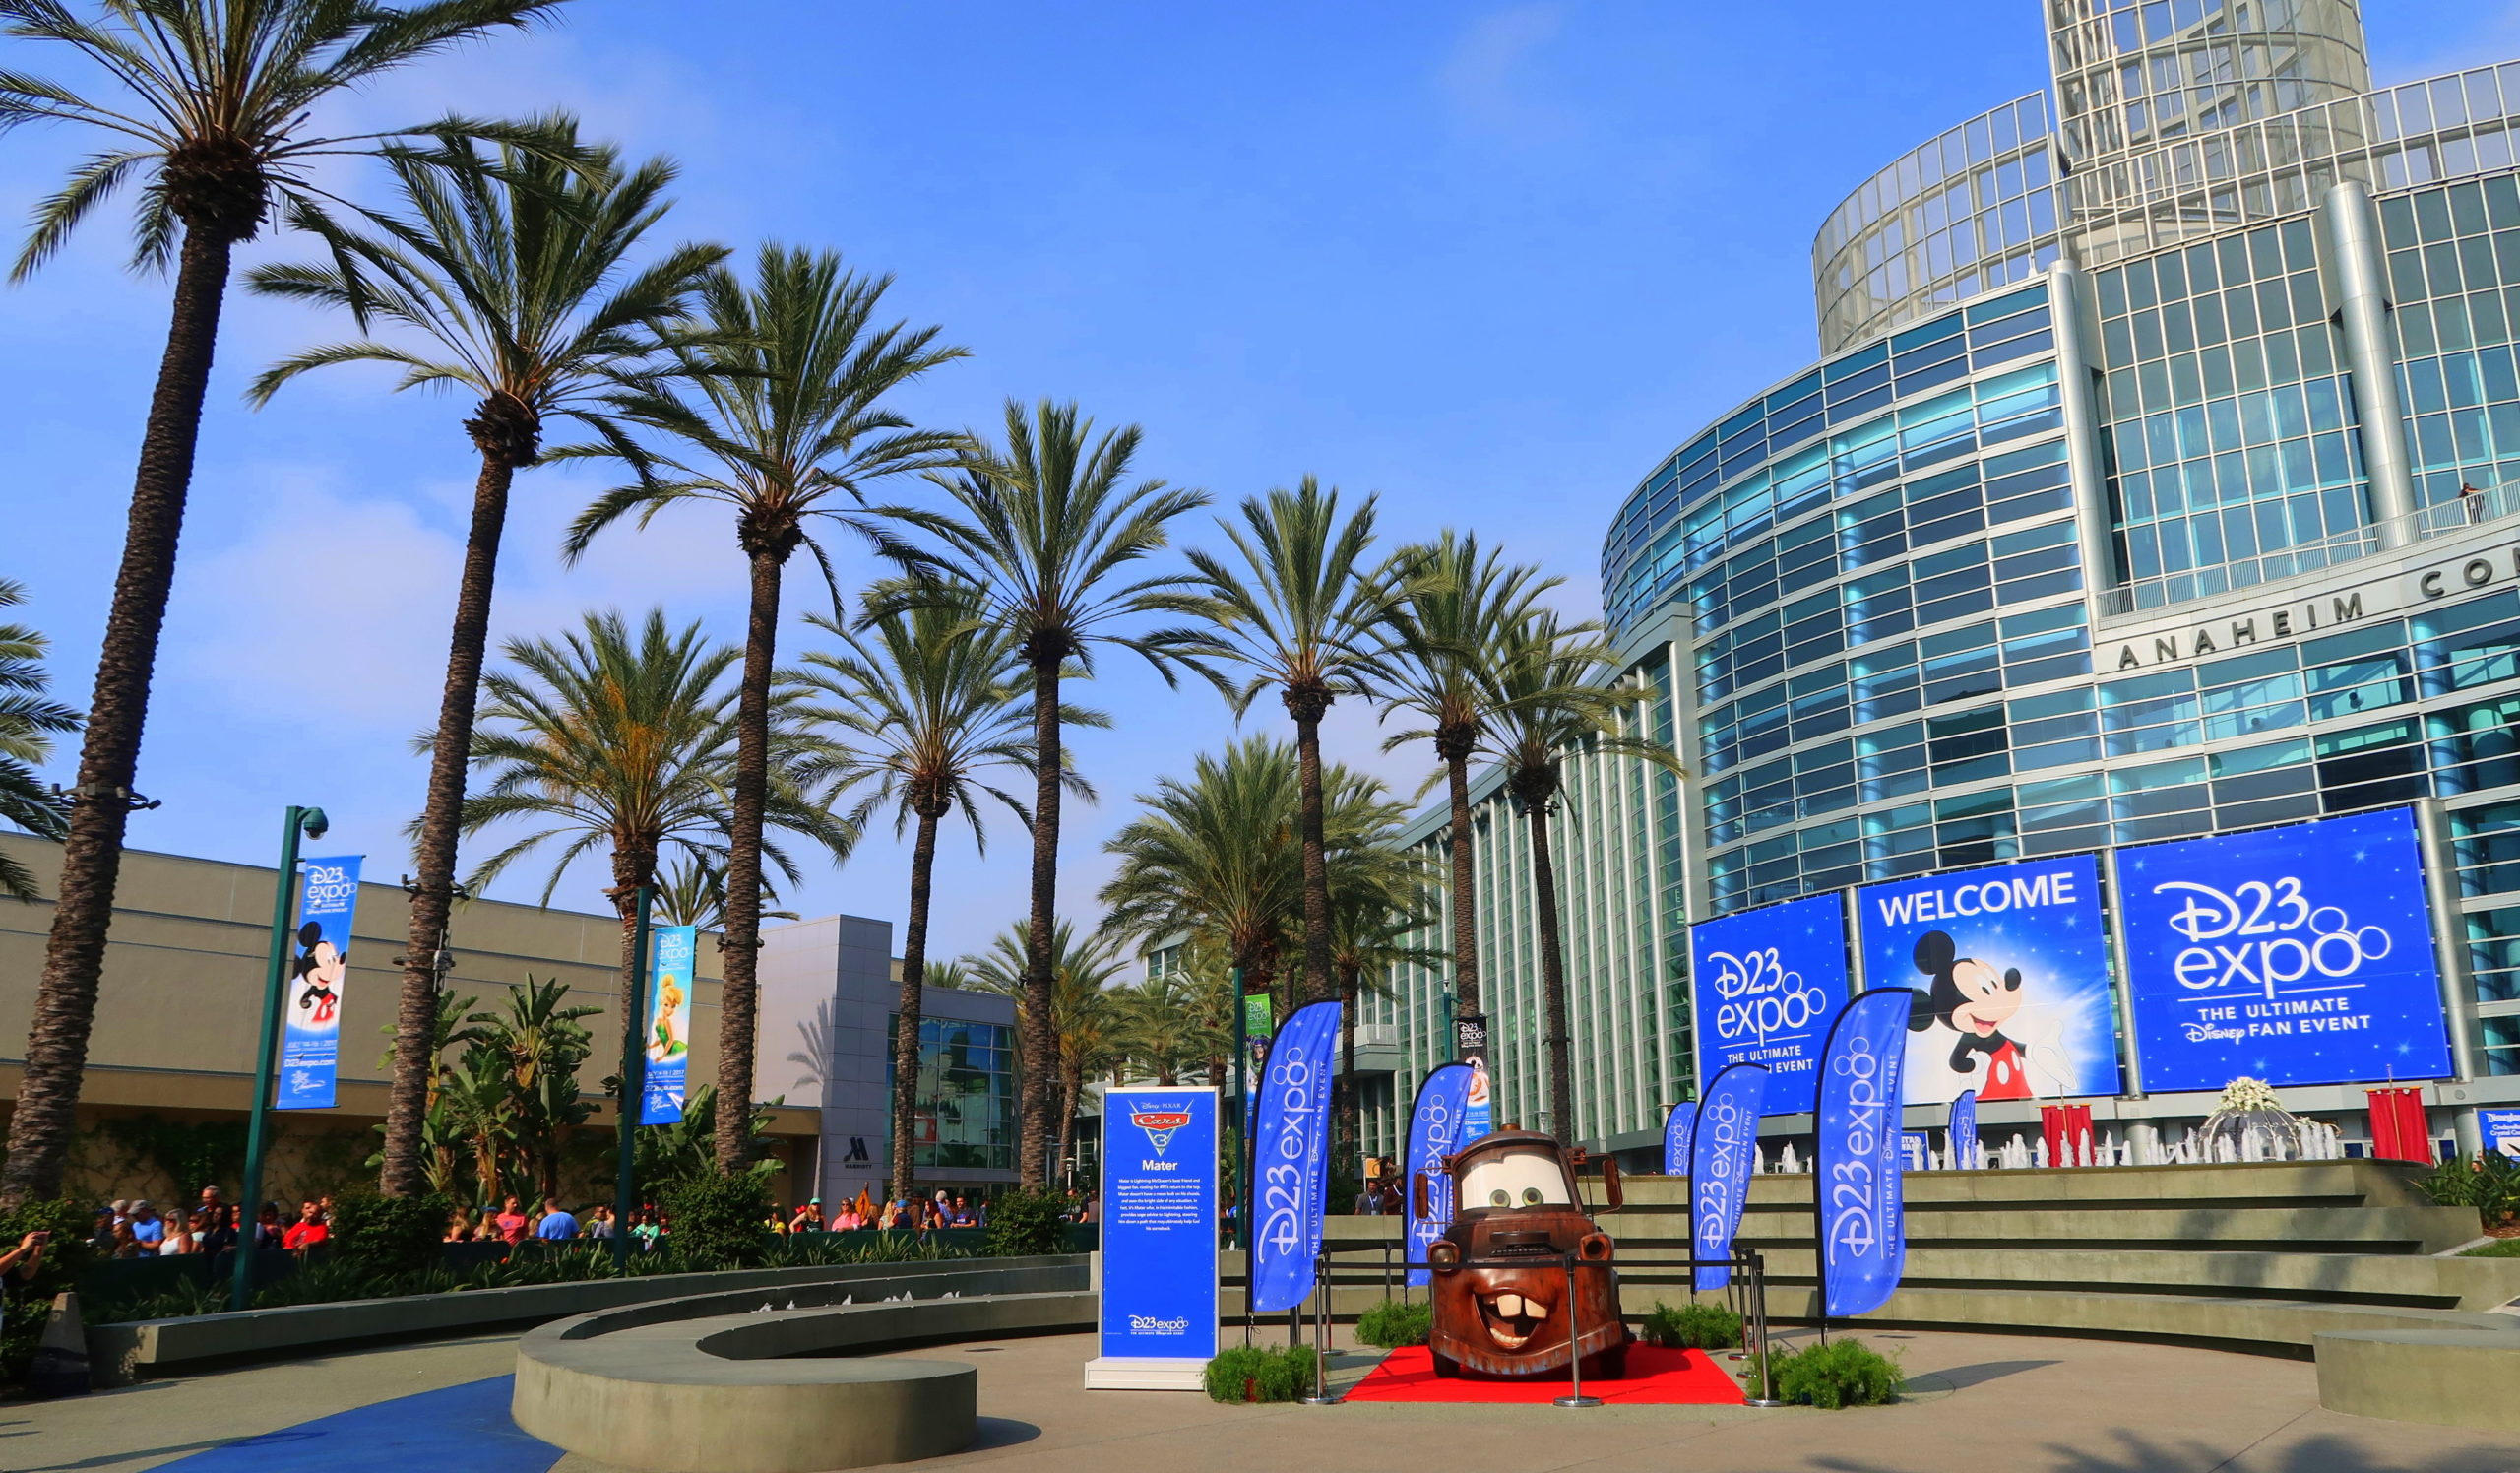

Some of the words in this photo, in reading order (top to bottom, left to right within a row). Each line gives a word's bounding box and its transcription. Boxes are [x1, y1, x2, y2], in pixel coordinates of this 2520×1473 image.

[2118, 592, 2362, 669] ANAHEIM
[307, 865, 343, 885] D23
[307, 881, 354, 901] expo
[1878, 871, 2077, 927] WELCOME
[2153, 876, 2309, 942] D23
[1708, 947, 1783, 1001] D23
[2174, 924, 2377, 999] expo
[1459, 1022, 1478, 1033] D23
[1717, 983, 1819, 1047] expo
[2181, 1022, 2245, 1045] Disney
[2248, 1020, 2292, 1037] FAN
[2300, 1014, 2371, 1033] EVENT
[2198, 1006, 2236, 1021] THE
[2245, 997, 2350, 1018] ULTIMATE
[1460, 1029, 1484, 1041] expo
[1727, 1052, 1745, 1063] THE
[1749, 1045, 1801, 1061] ULTIMATE
[1317, 1061, 1327, 1099] EVENT
[1775, 1058, 1813, 1073] EVENT
[1888, 1055, 1897, 1097] EVENT
[1138, 1115, 1182, 1125] Cars
[1277, 1054, 1315, 1160] expo
[1841, 1045, 1886, 1156] expo
[1153, 1133, 1168, 1147] 3
[1422, 1100, 1452, 1177] expo
[1672, 1121, 1686, 1167] expo
[1710, 1099, 1741, 1177] expo
[1740, 1136, 1749, 1158] FAN
[1745, 1109, 1754, 1133] EVENT
[1142, 1159, 1178, 1171] Mater
[1258, 1163, 1302, 1264] D23
[1310, 1169, 1319, 1229] ULTIMATE
[1697, 1180, 1729, 1257] D23
[1829, 1160, 1875, 1266] D23
[1886, 1167, 1896, 1228] ULTIMATE
[1310, 1232, 1319, 1256] THE
[1128, 1314, 1156, 1329] D23
[1157, 1317, 1187, 1332] expo
